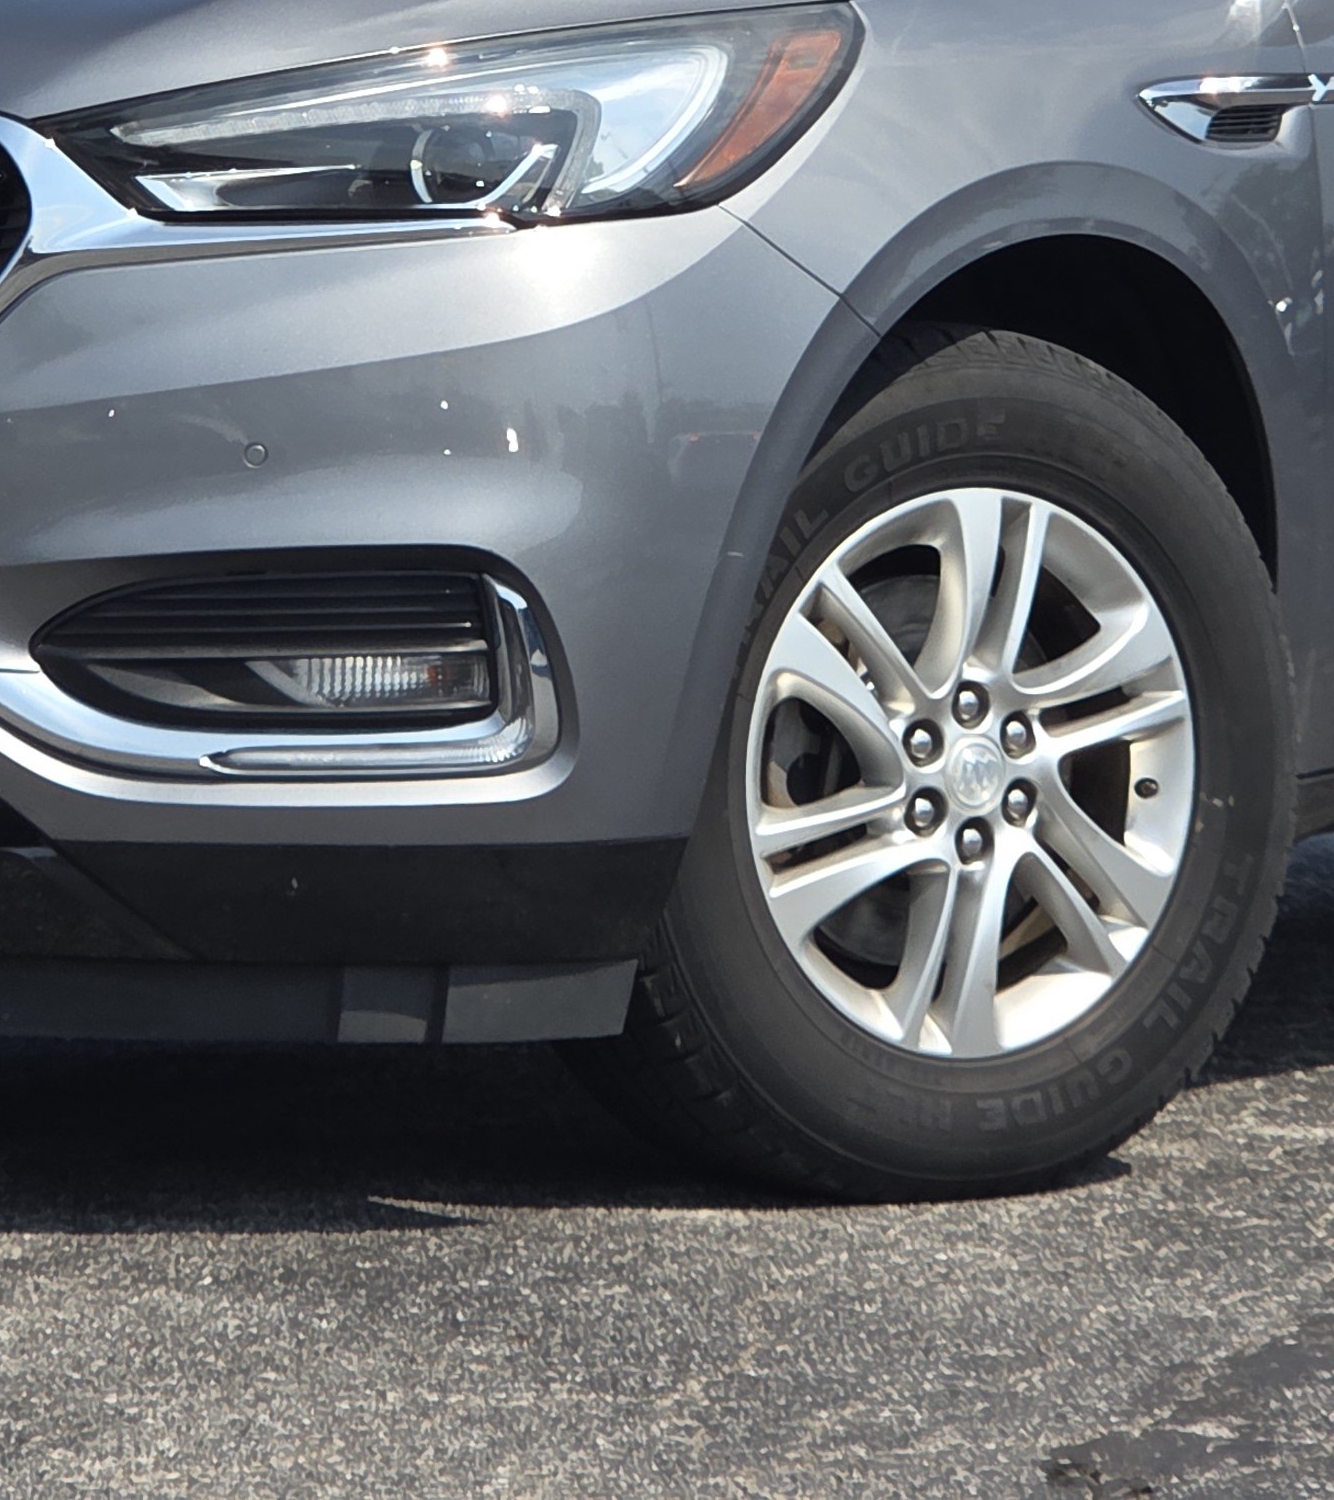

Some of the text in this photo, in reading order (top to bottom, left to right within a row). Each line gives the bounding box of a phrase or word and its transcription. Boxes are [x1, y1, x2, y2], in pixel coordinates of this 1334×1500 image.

[752, 407, 1007, 612] AIL GUIDE
[974, 852, 1255, 1132] TRAIL GUIDE
